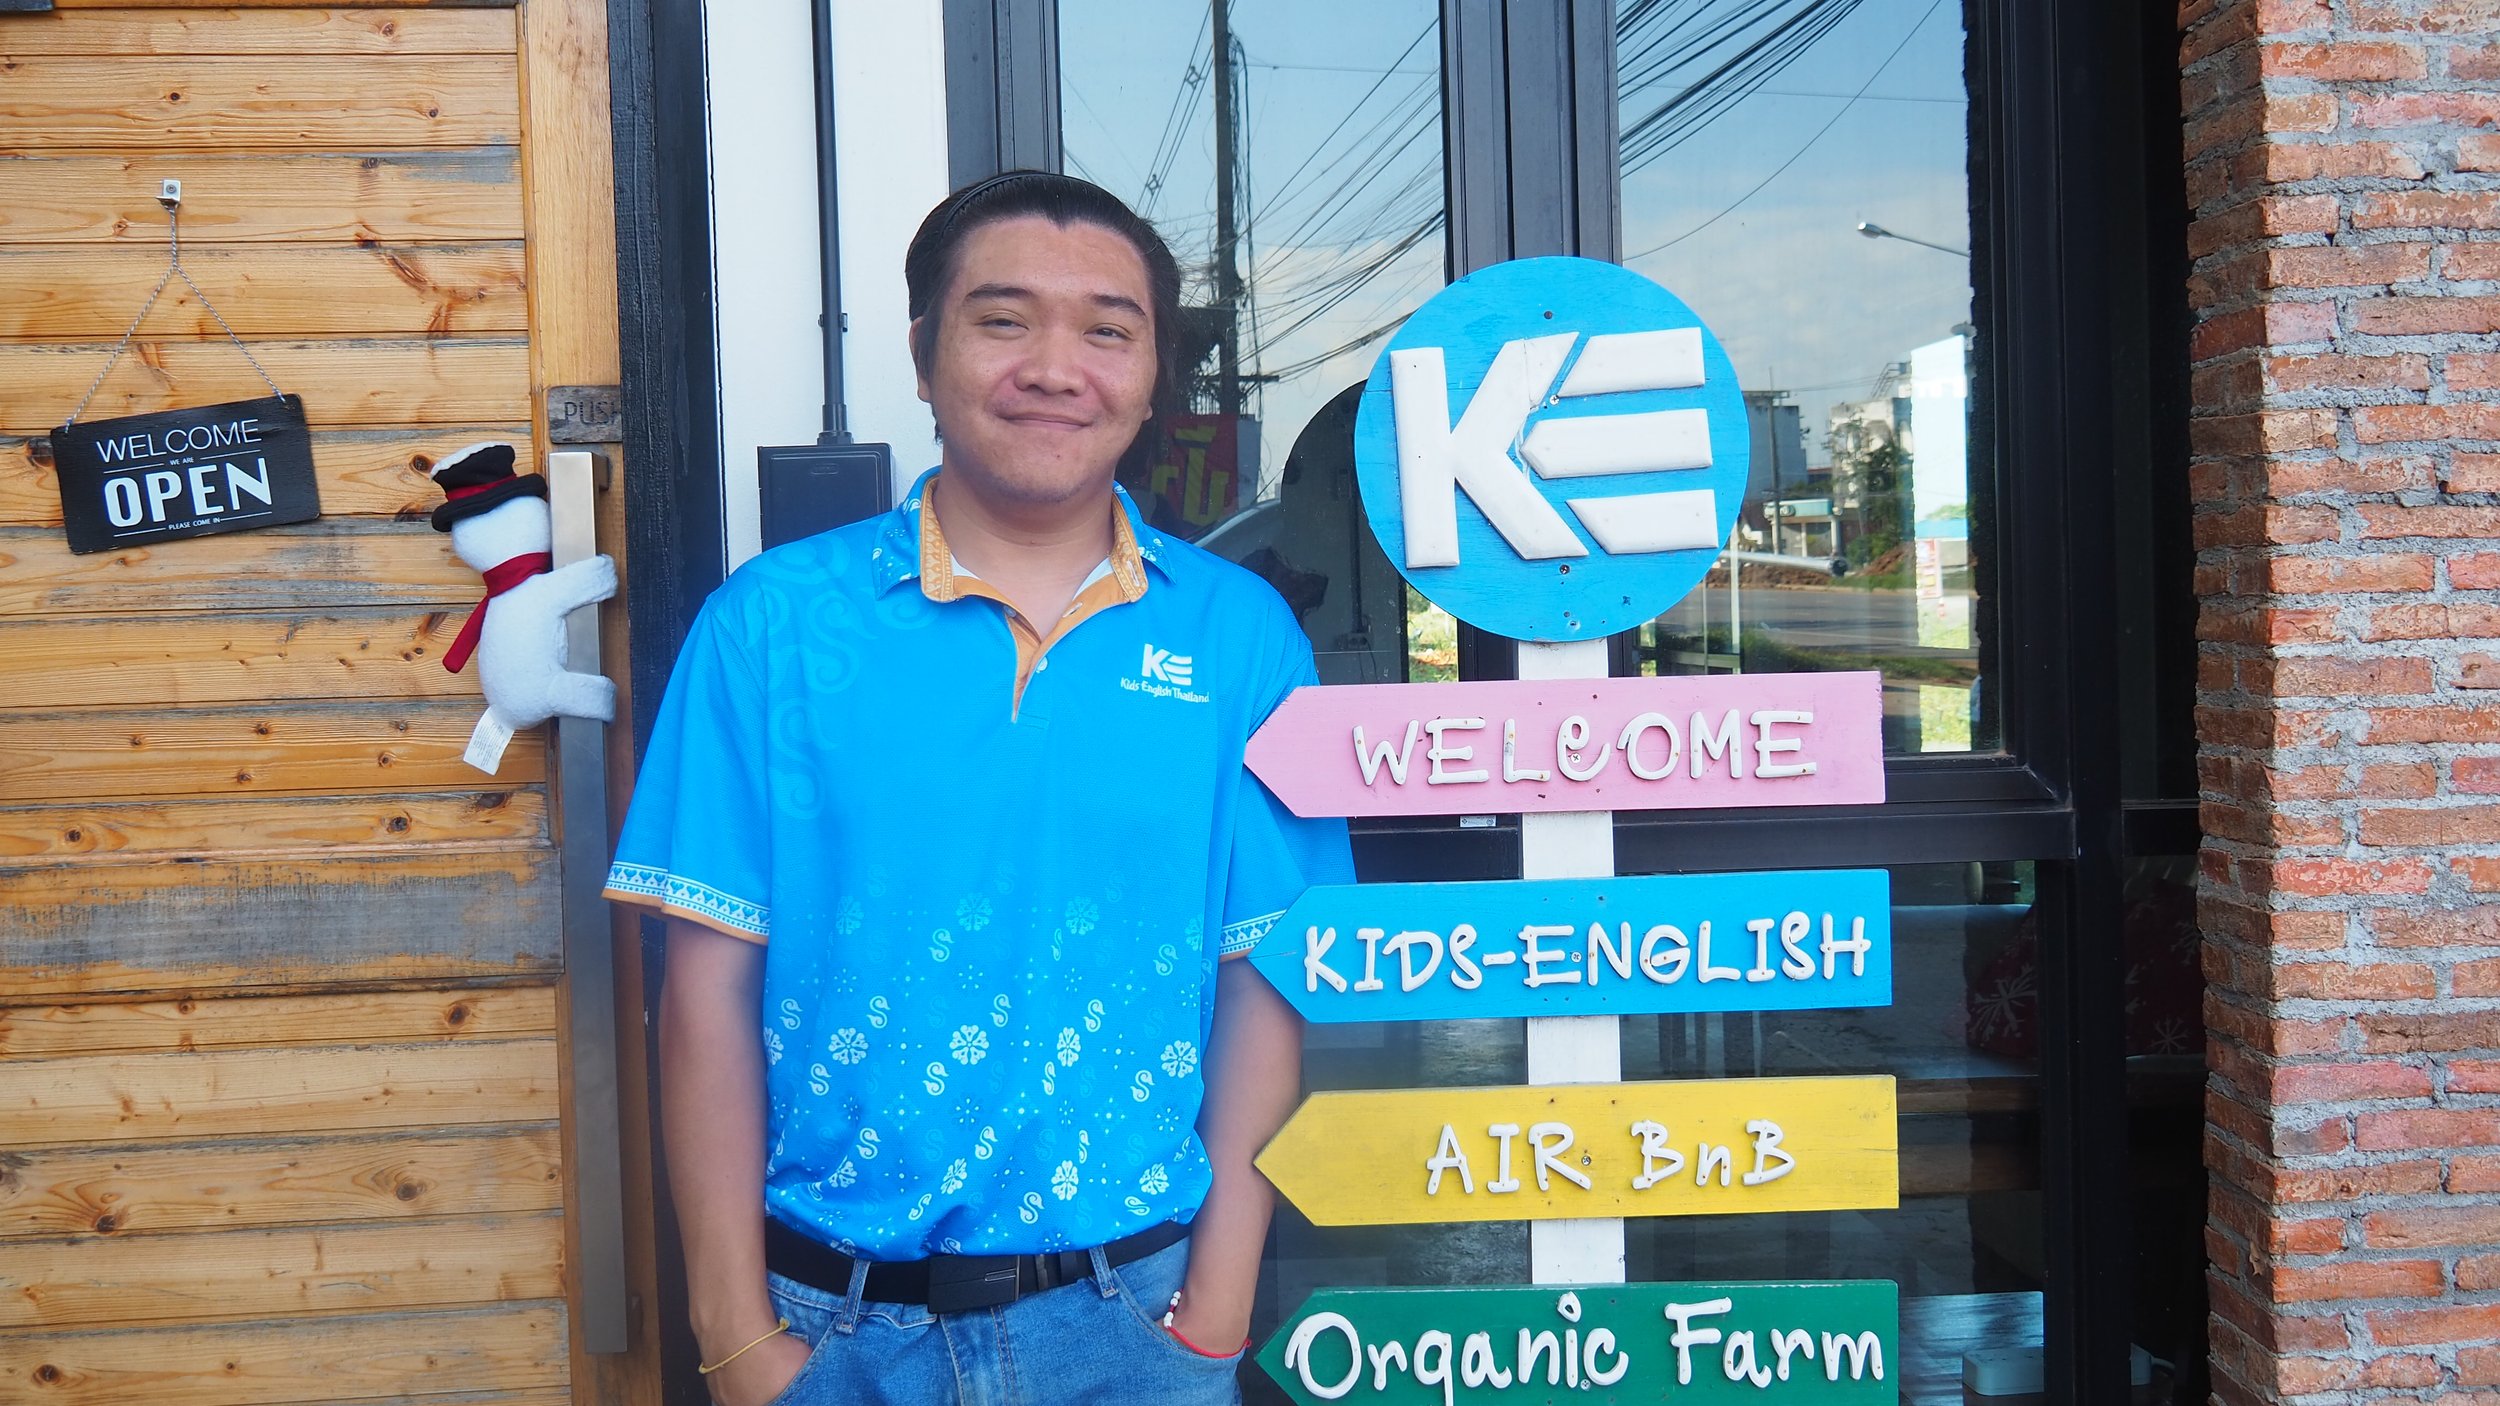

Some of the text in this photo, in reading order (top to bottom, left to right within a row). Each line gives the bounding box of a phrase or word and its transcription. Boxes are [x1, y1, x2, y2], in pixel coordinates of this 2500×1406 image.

[96, 418, 262, 463] WELCOME
[182, 456, 194, 464] ARE
[1390, 326, 1718, 570] KE
[103, 457, 272, 528] OPEN
[168, 521, 191, 530] PLEASE
[192, 518, 211, 526] COME
[1120, 676, 1210, 703] Kids English Thailand
[1141, 643, 1193, 686] KE
[1303, 910, 1872, 994] KIDS-ENGLISH
[1426, 1119, 1796, 1196] AIR BnB
[1284, 1291, 1885, 1406] Organic Farm
